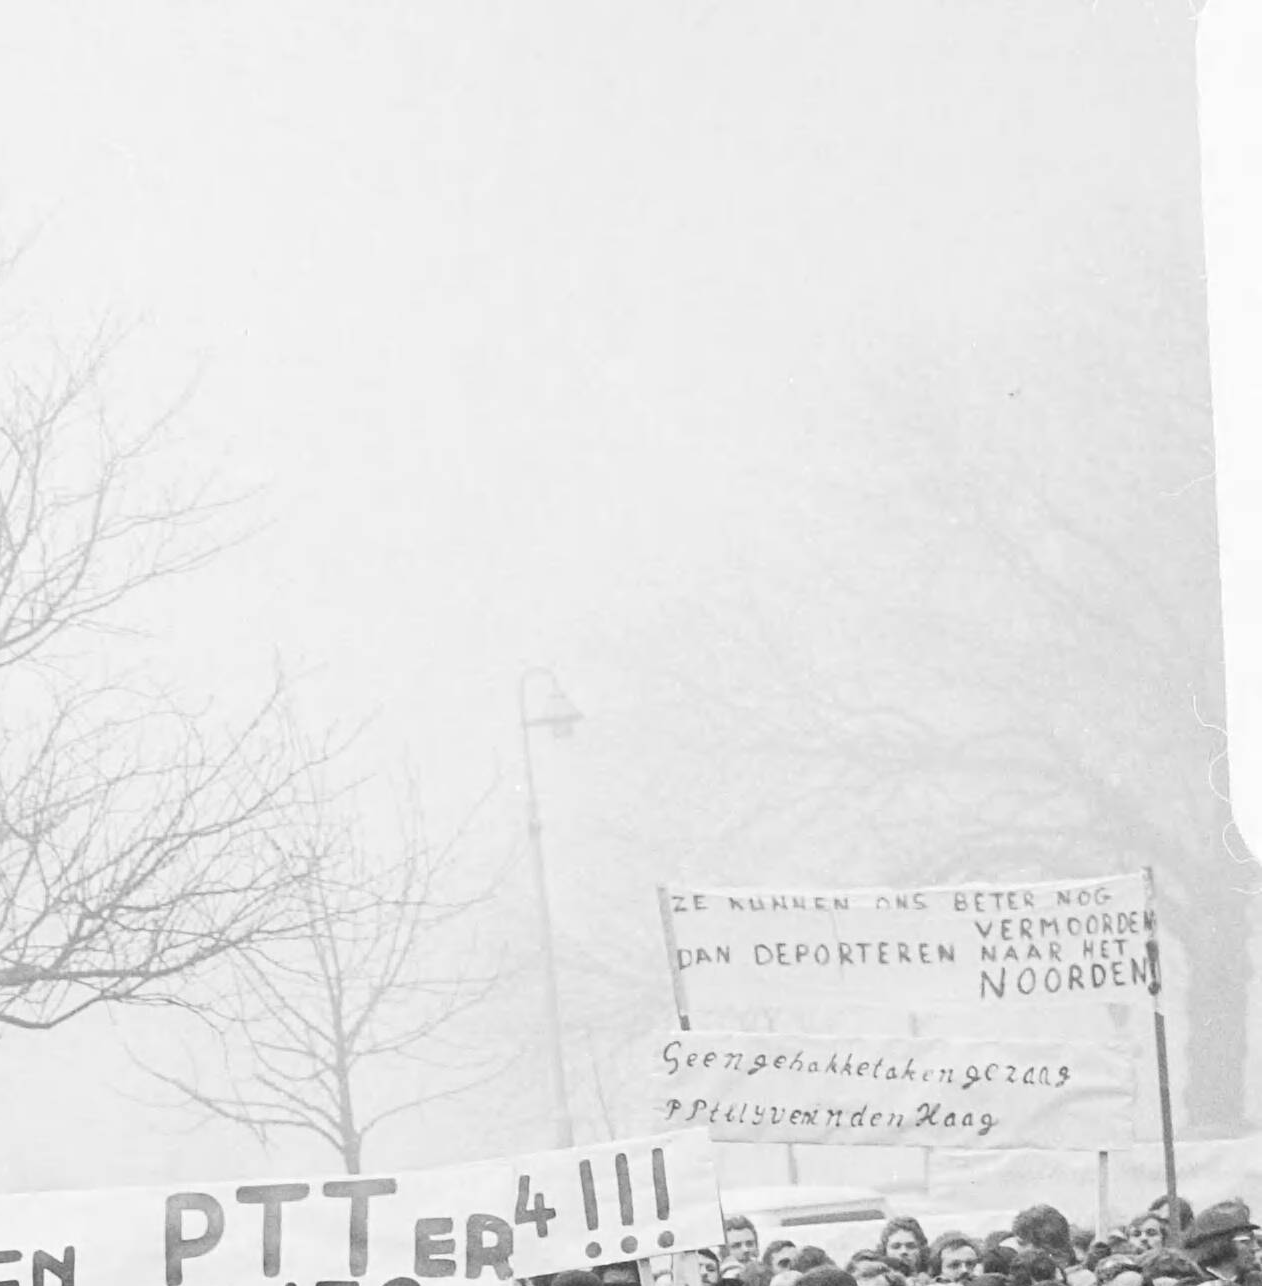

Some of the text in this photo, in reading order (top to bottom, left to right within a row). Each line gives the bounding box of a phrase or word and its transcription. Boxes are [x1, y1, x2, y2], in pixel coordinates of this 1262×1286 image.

[672, 895, 709, 912] ZE
[953, 890, 1035, 912] BETER
[1057, 887, 1111, 906] NOG
[974, 910, 1155, 941] VERMOORDEN
[677, 939, 1128, 970] DAN DEPORTEREN NAAR HET
[915, 1102, 995, 1136] Haag
